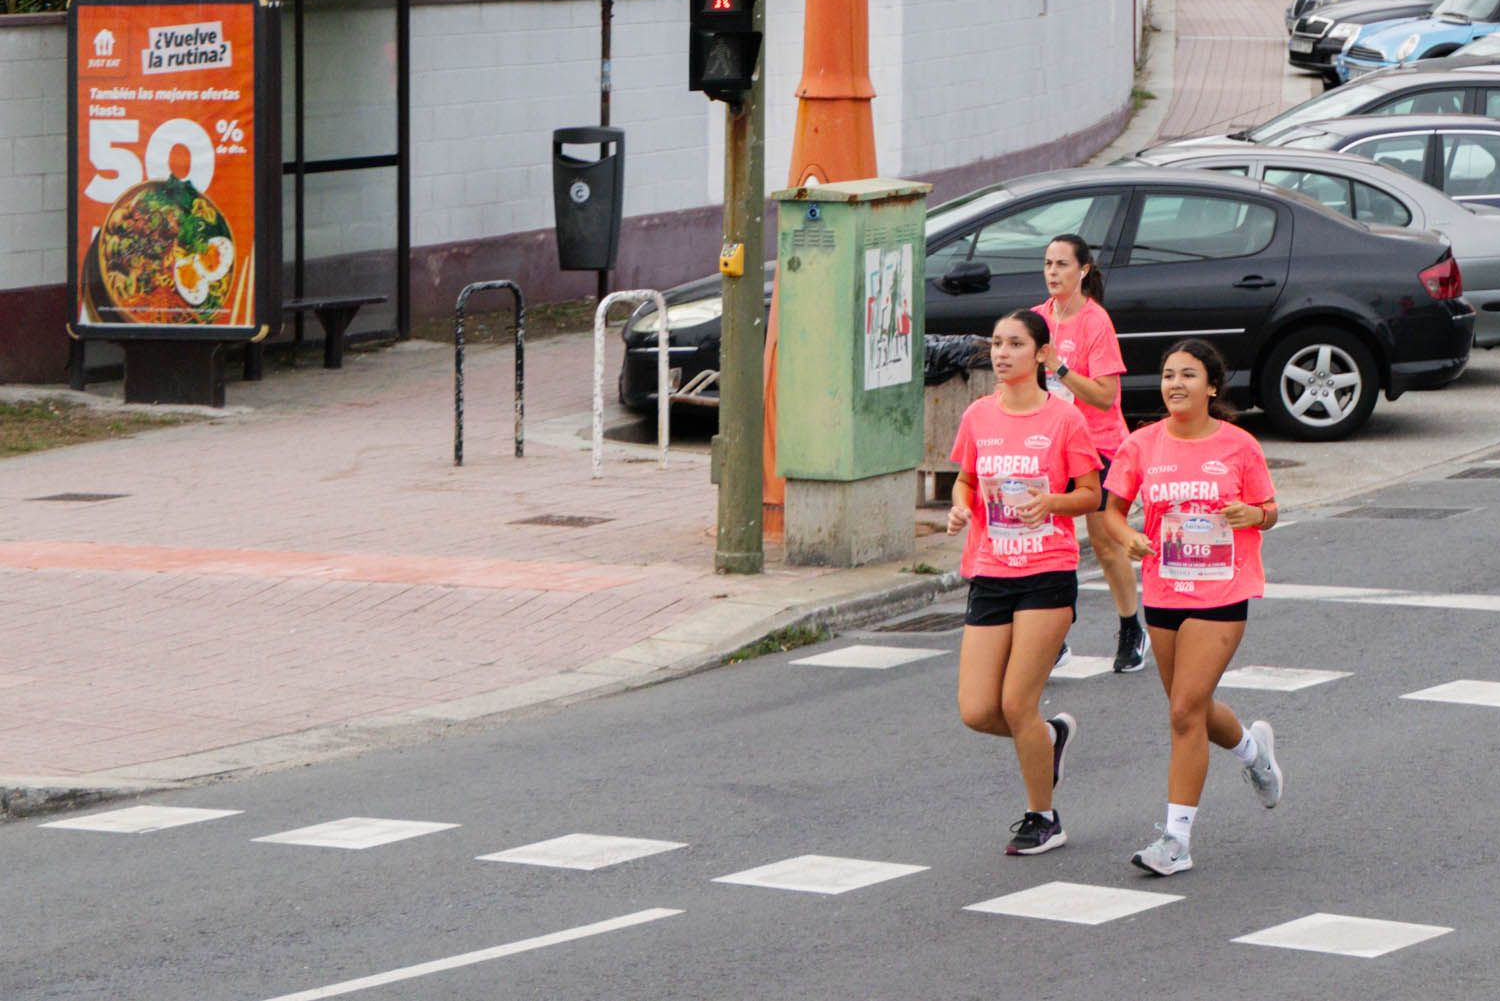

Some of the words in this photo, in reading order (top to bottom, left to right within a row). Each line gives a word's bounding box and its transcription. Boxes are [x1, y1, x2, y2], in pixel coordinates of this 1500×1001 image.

[155, 27, 218, 50] ¿Vuelve
[148, 51, 163, 68] la
[167, 44, 228, 67] rutina?
[89, 87, 136, 101] También
[137, 87, 154, 101] las
[155, 87, 199, 103] mejores
[200, 86, 241, 100] ofertas
[88, 104, 126, 117] Hasta
[976, 455, 1040, 475] CARRERA
[1149, 480, 1220, 503] CARRERA
[991, 535, 1044, 556] MUJER
[1182, 544, 1212, 557] 016
